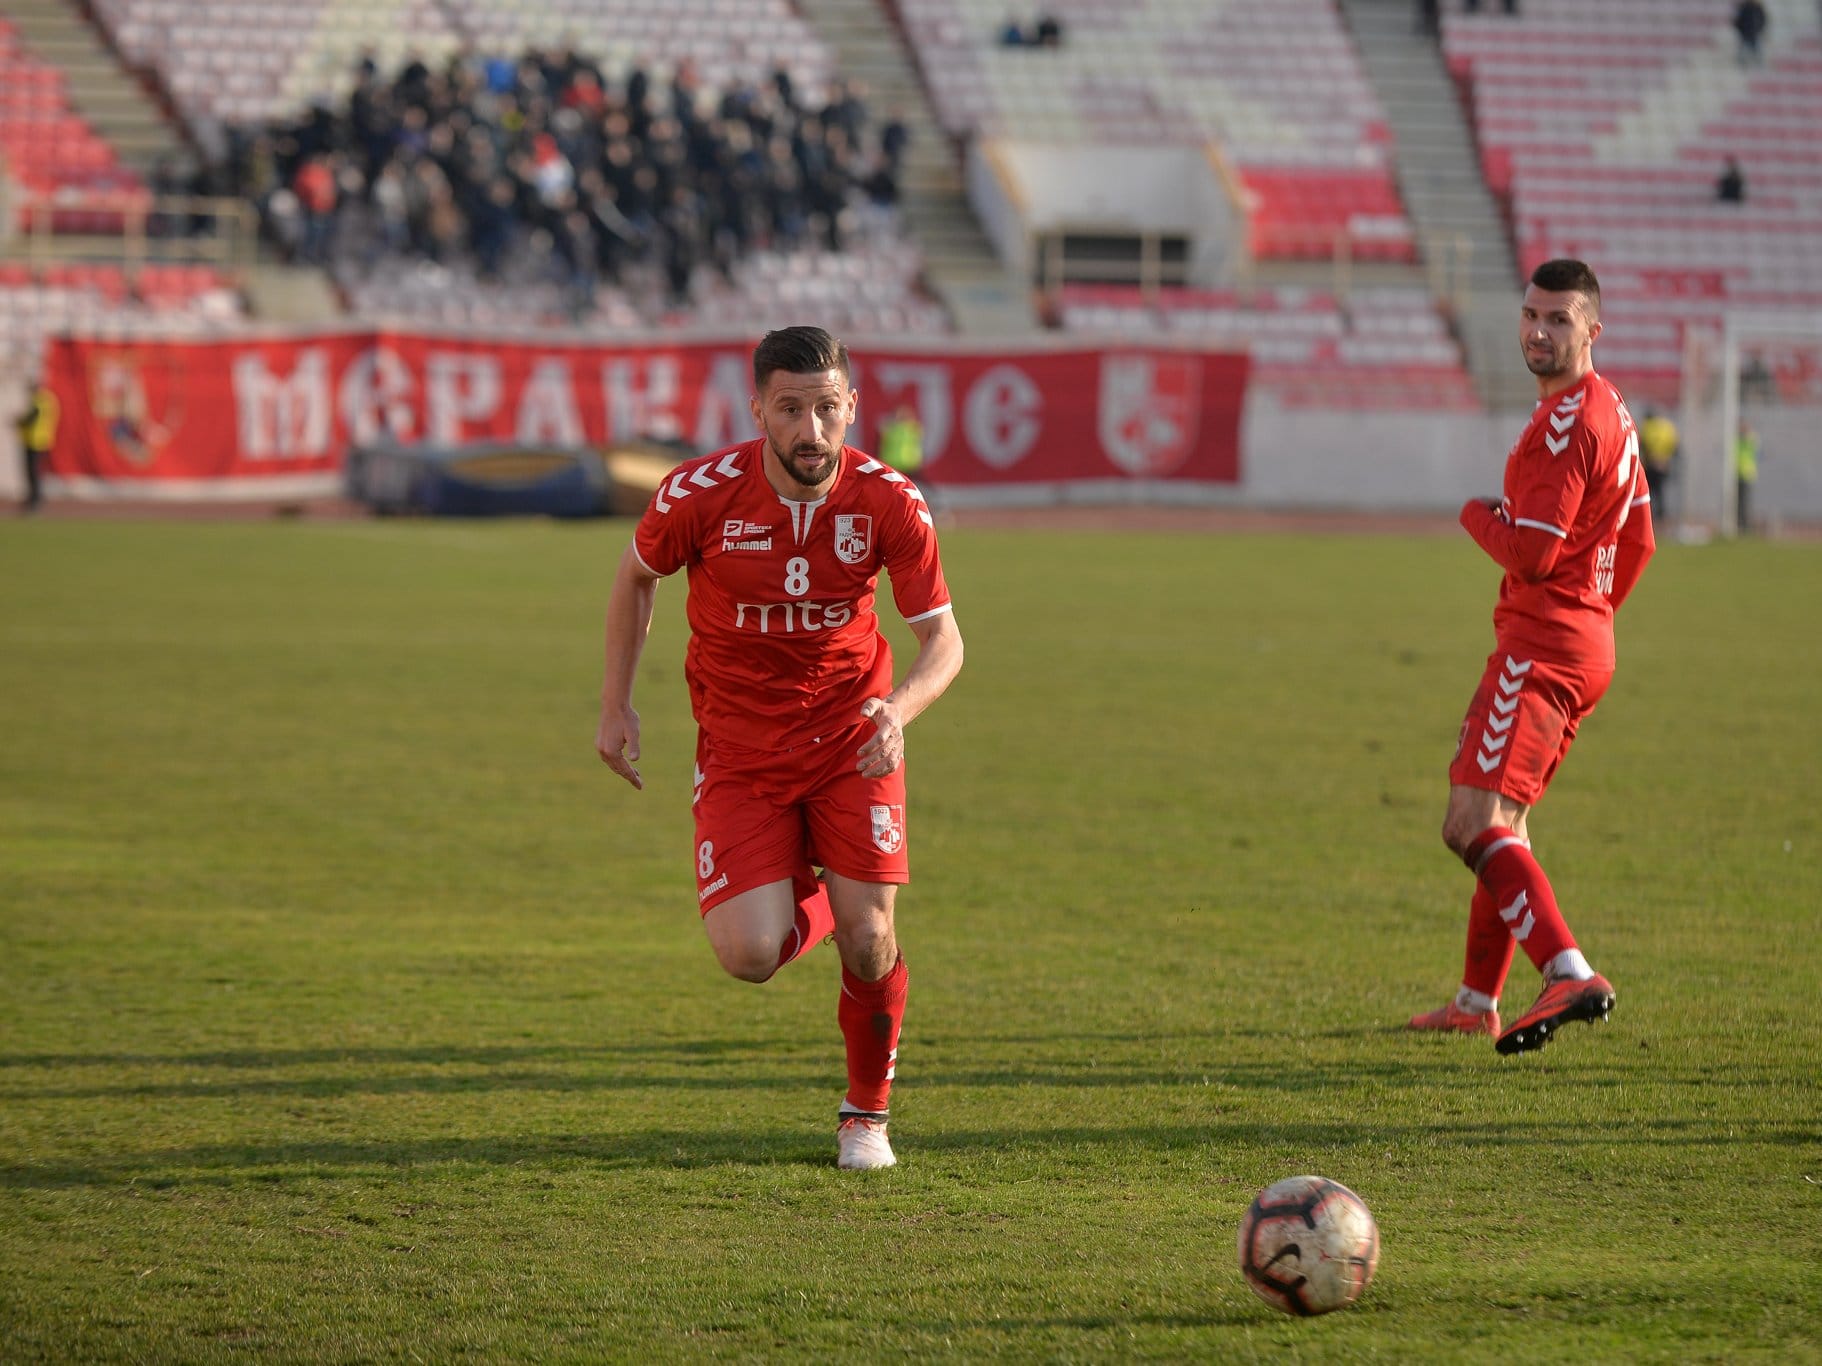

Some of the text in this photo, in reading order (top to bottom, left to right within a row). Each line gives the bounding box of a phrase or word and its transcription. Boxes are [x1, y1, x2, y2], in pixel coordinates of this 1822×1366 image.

[722, 537, 772, 551] hummel
[784, 557, 810, 596] 8
[736, 600, 851, 633] mts
[699, 841, 714, 878] 8
